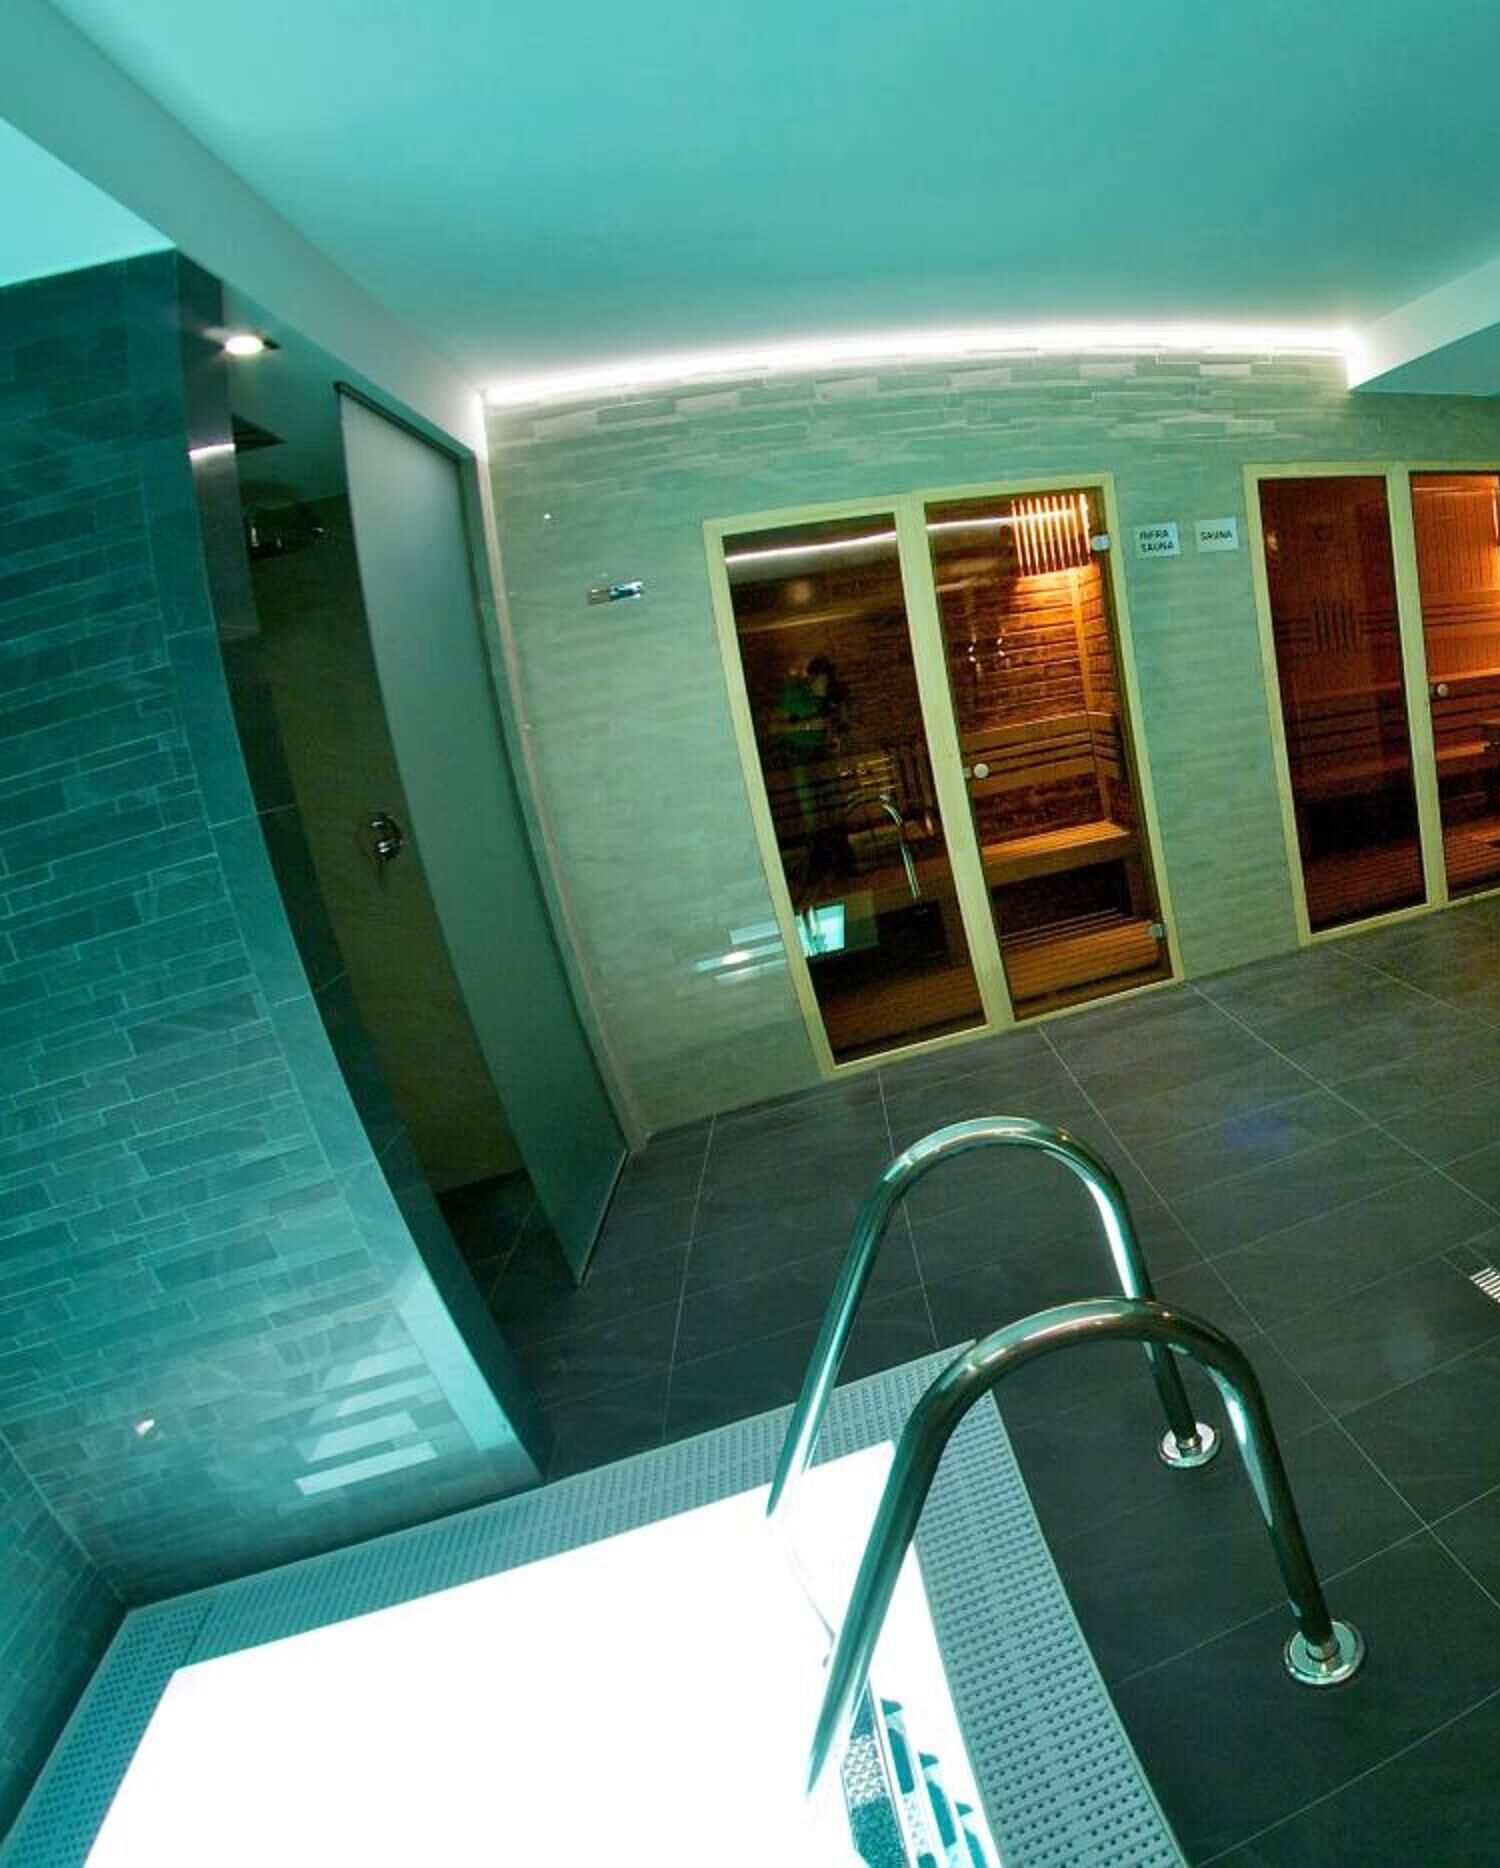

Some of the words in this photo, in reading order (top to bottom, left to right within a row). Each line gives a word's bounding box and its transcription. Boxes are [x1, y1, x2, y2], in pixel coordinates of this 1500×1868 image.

[1139, 529, 1169, 541] INFRA
[1200, 529, 1233, 541] SAUNA
[1141, 542, 1174, 552] SAUNA
